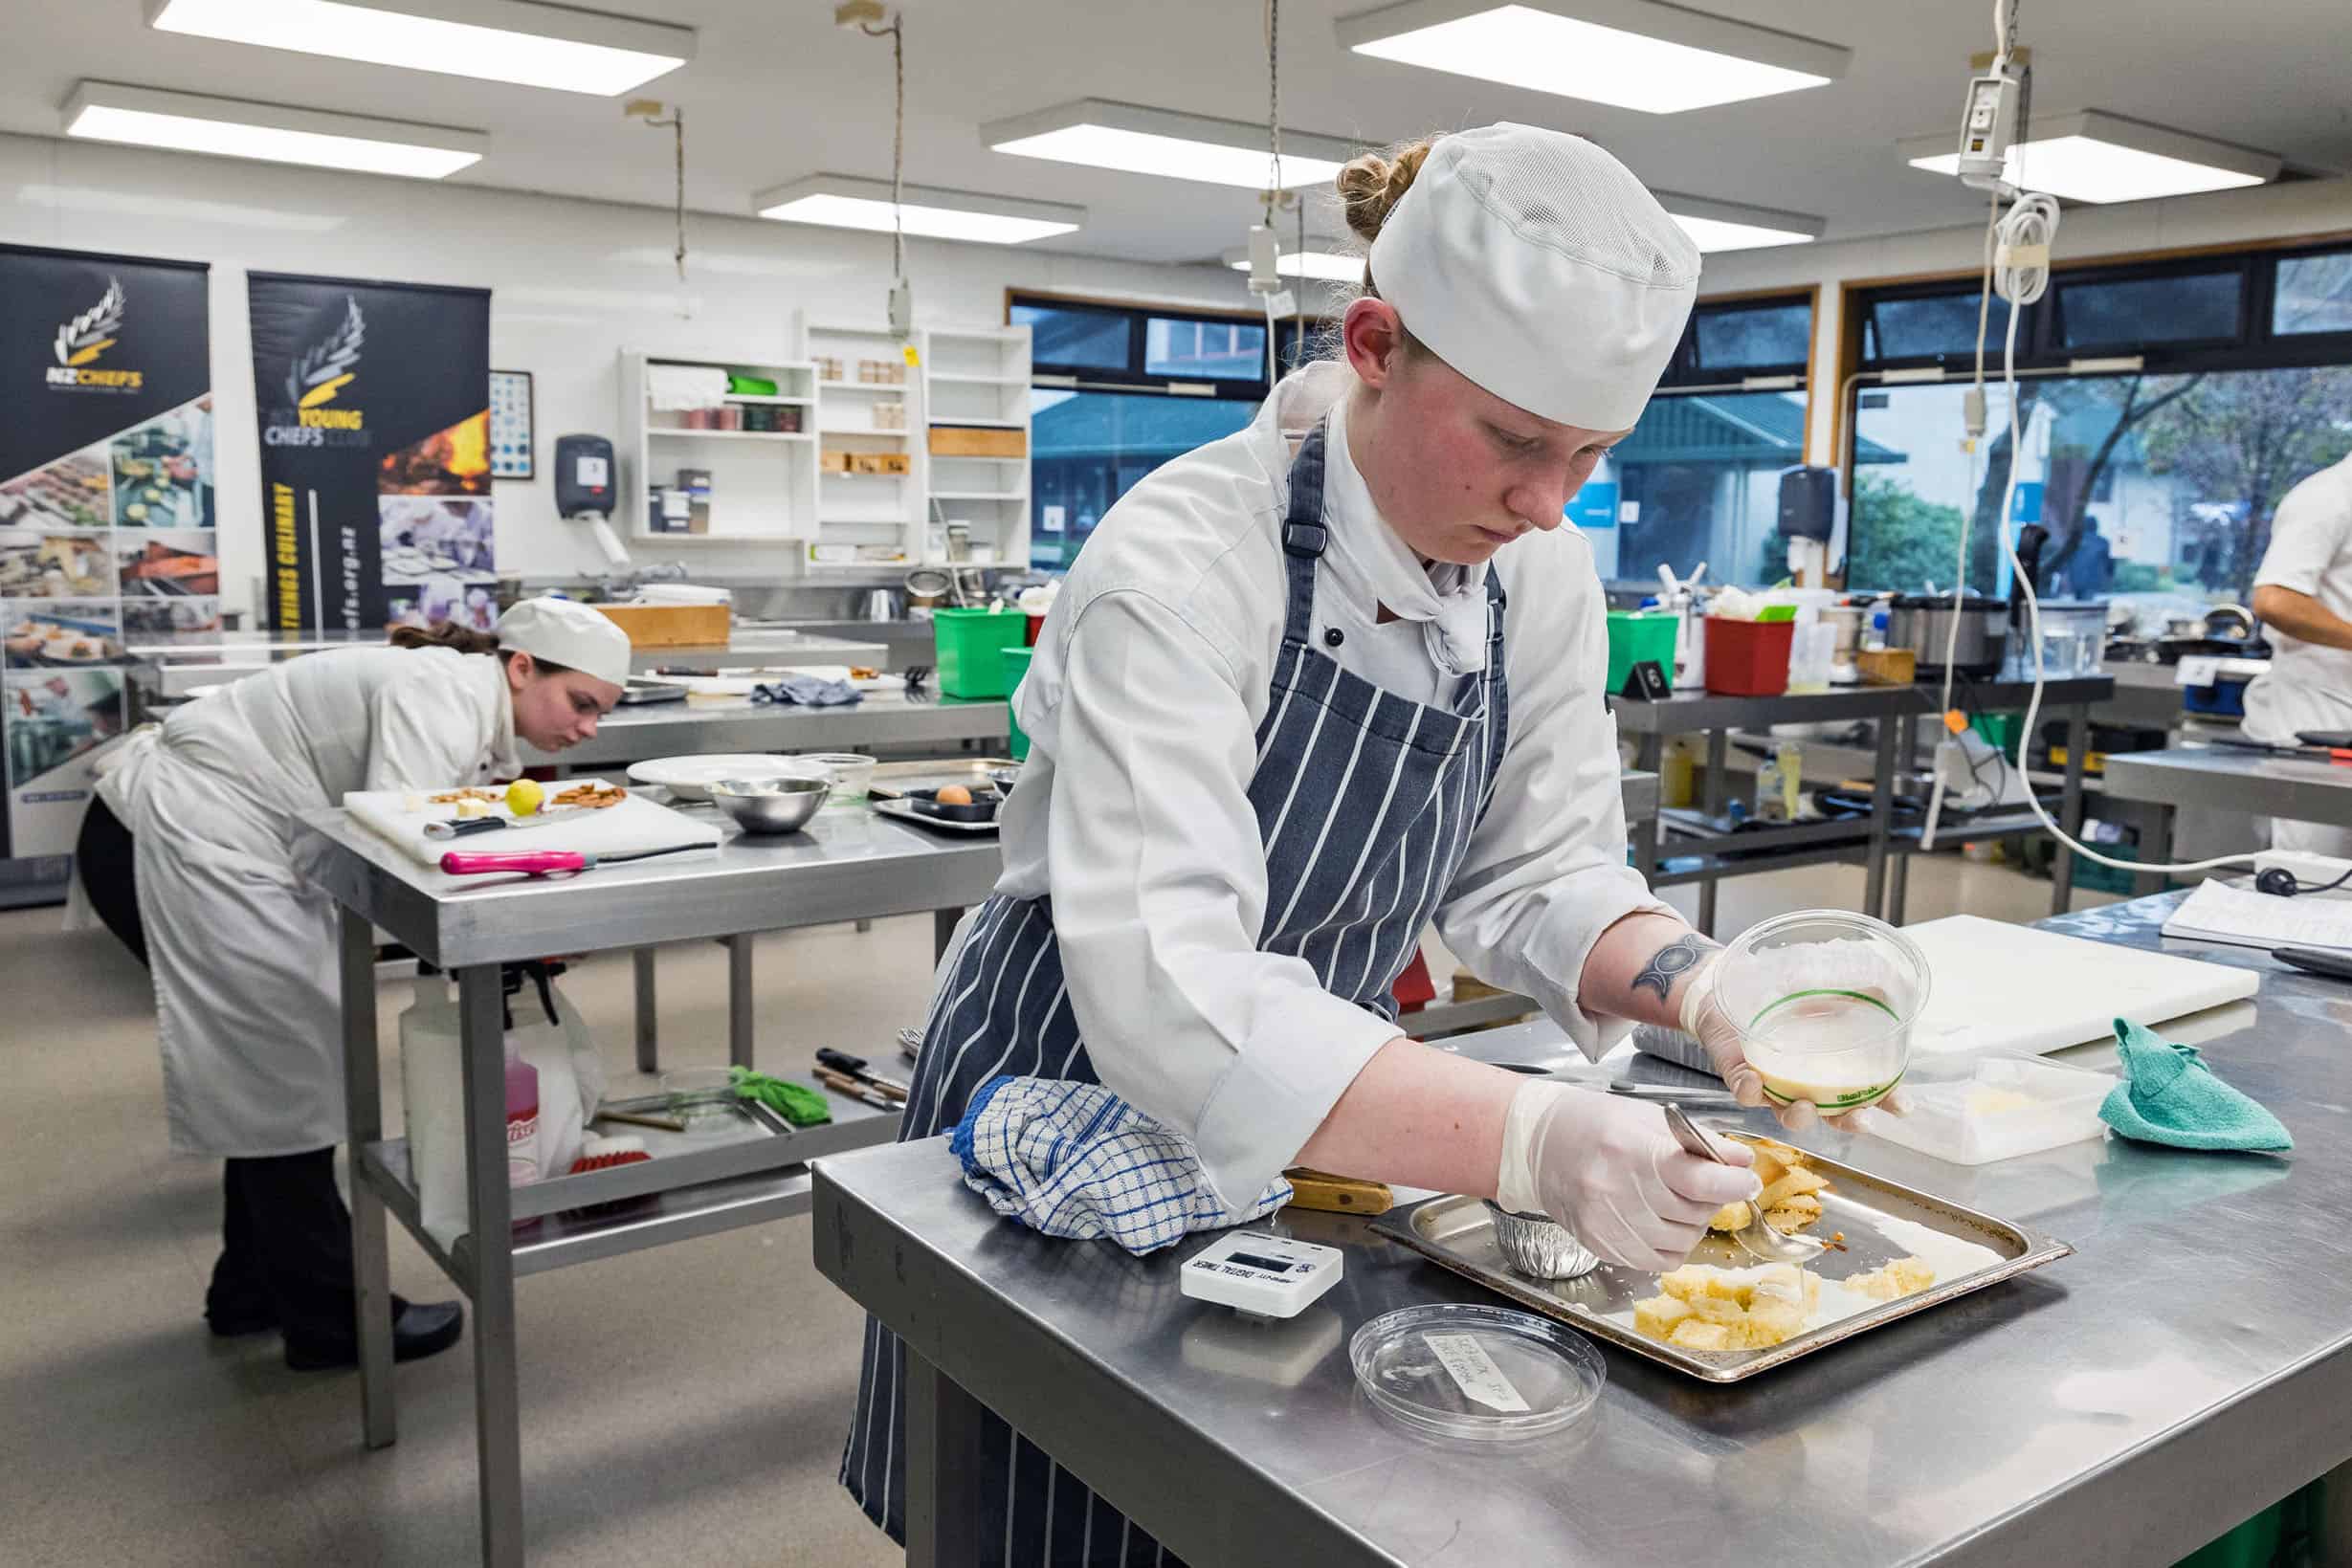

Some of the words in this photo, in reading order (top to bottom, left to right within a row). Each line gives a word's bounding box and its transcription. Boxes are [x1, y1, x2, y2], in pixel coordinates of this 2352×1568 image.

[298, 409, 363, 431] YOUNG
[264, 426, 323, 447] CHEFS
[273, 481, 298, 565] CULINARY
[277, 566, 300, 629] THINGS
[1192, 1259, 1220, 1271] TIMER
[1222, 1265, 1255, 1279] DIGITAL
